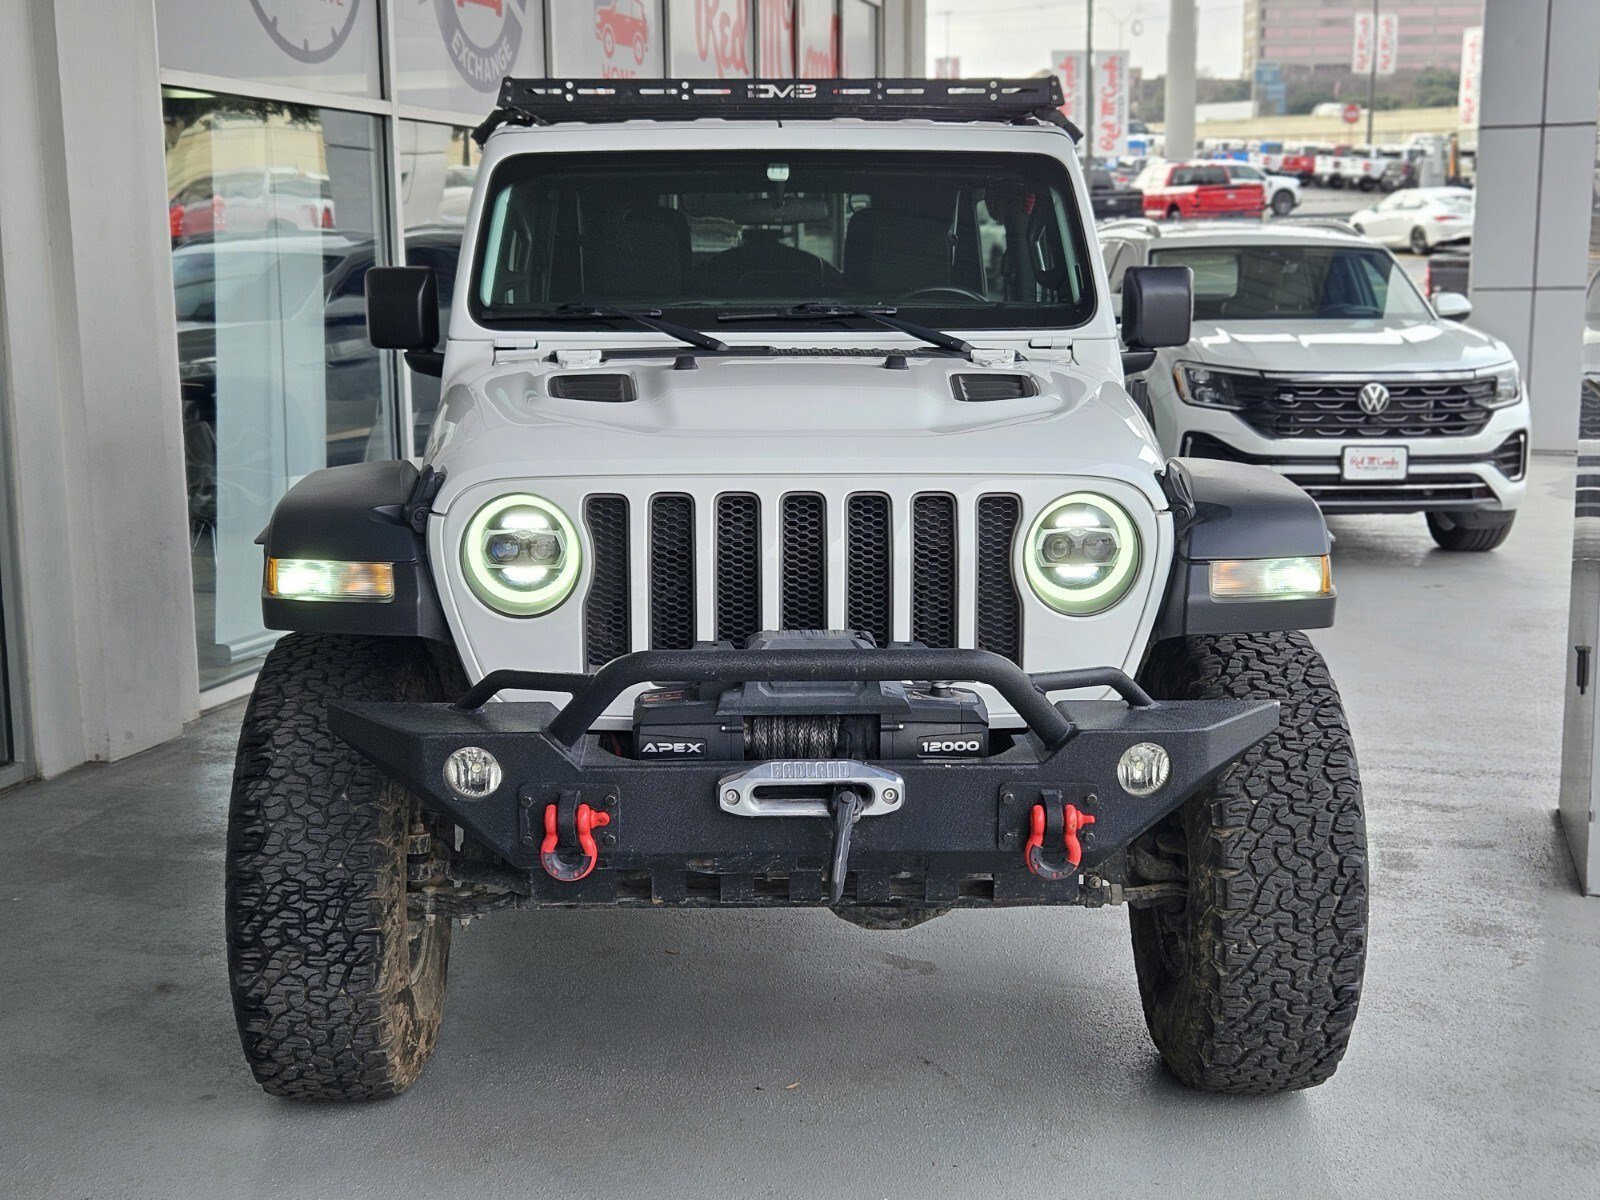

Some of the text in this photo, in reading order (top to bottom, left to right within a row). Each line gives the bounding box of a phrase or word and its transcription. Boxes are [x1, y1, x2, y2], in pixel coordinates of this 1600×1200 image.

[451, 29, 513, 82] EXCHANGE
[641, 742, 702, 753] APEX
[922, 740, 980, 753] 12000
[770, 761, 850, 779] BADLAND
